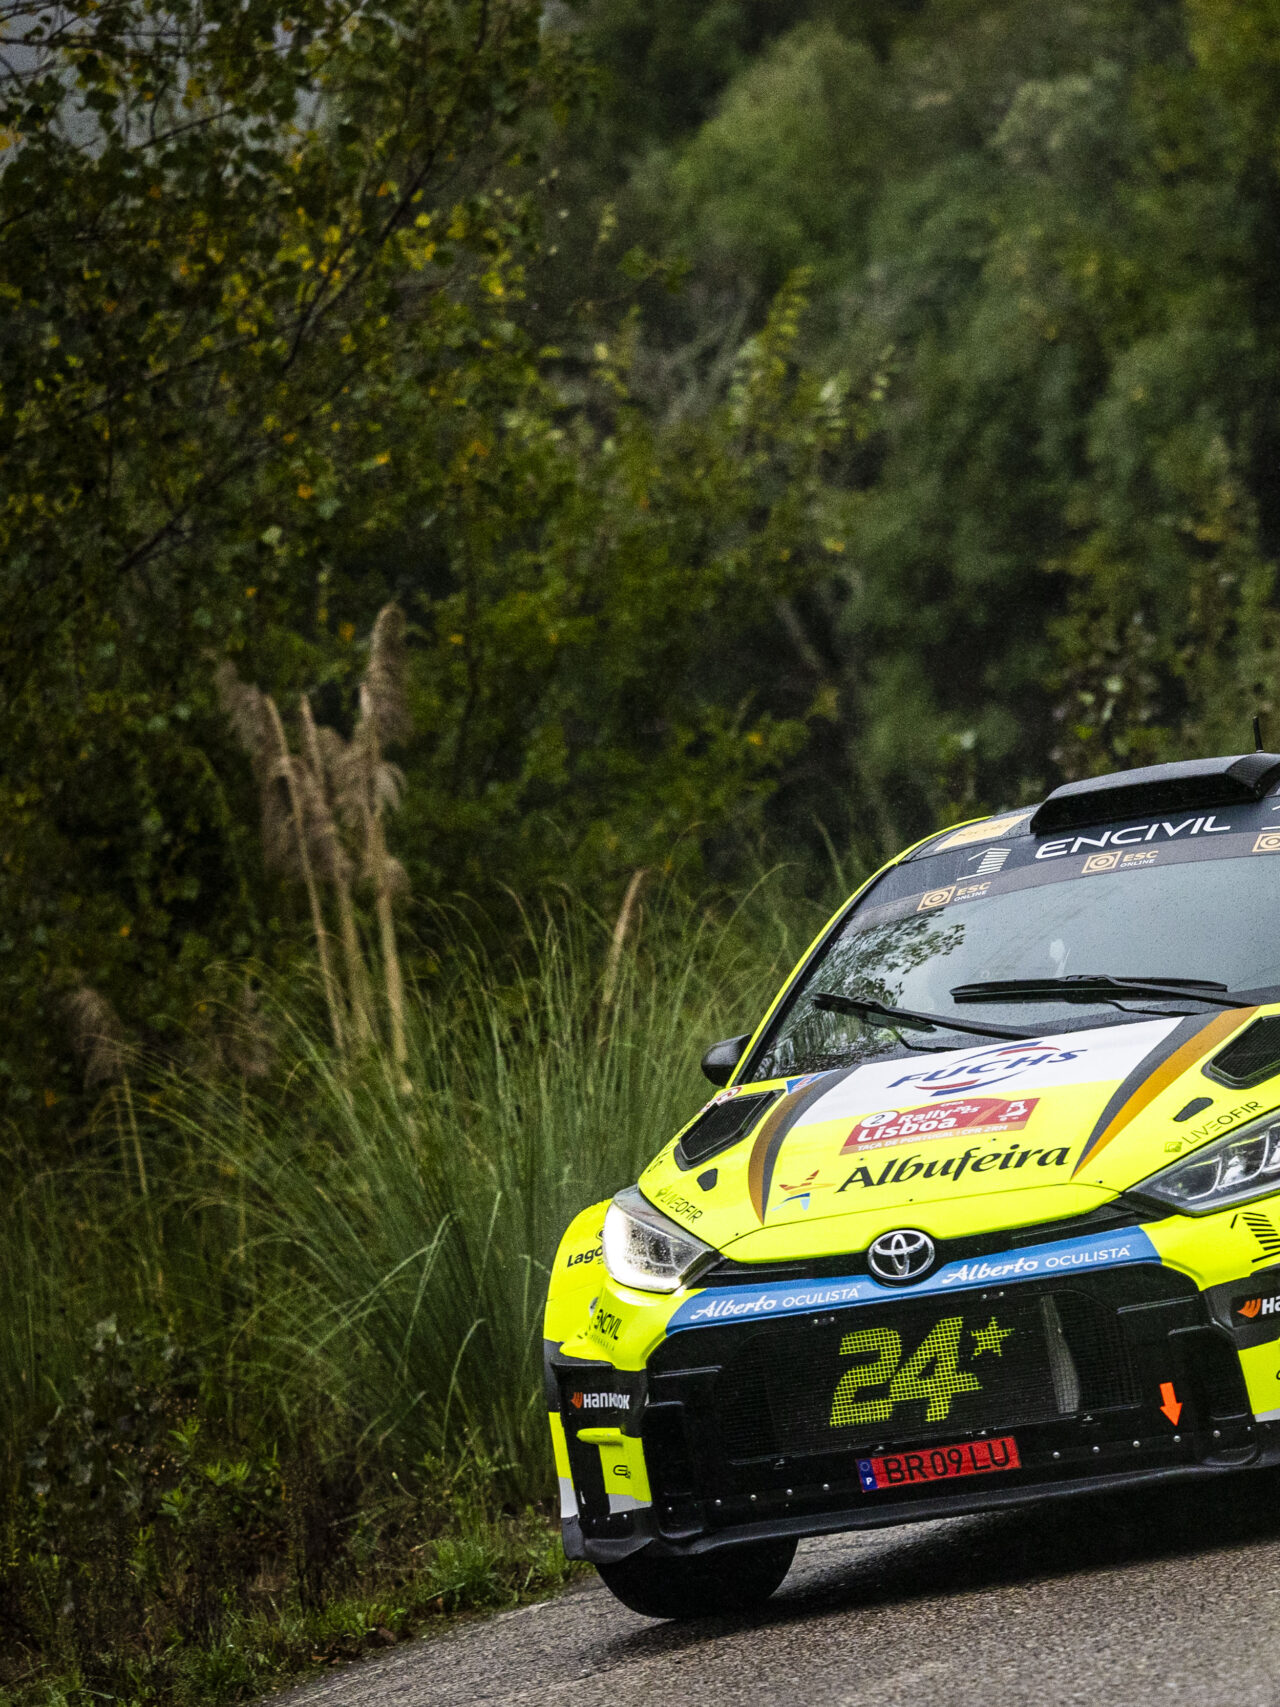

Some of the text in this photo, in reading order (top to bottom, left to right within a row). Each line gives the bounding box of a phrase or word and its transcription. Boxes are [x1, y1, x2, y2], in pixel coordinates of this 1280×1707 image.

[1035, 815, 1231, 860] ENCIVIL
[1119, 858, 1155, 868] ONLINE
[1122, 850, 1159, 862] ESC
[953, 890, 987, 902] ONLINE
[956, 881, 992, 896] ESC
[886, 1049, 1089, 1089] FUCHS
[870, 1114, 886, 1125] 2
[897, 1106, 953, 1125] Rally
[1182, 1101, 1264, 1145] LIVEOFIR
[857, 1117, 957, 1142] Lisboa
[884, 1139, 898, 1147] DE
[899, 1132, 954, 1145] PORTUGAL
[961, 1127, 983, 1136] CPR
[836, 1143, 1071, 1194] Albufeira
[567, 1245, 603, 1268] Lago
[941, 1246, 1131, 1285] Alberto OCULISTA
[690, 1287, 859, 1320] Alberto OCULISTA
[829, 1316, 983, 1428] 24
[882, 1440, 1010, 1484] BR 09 LU
[866, 1477, 873, 1486] P
